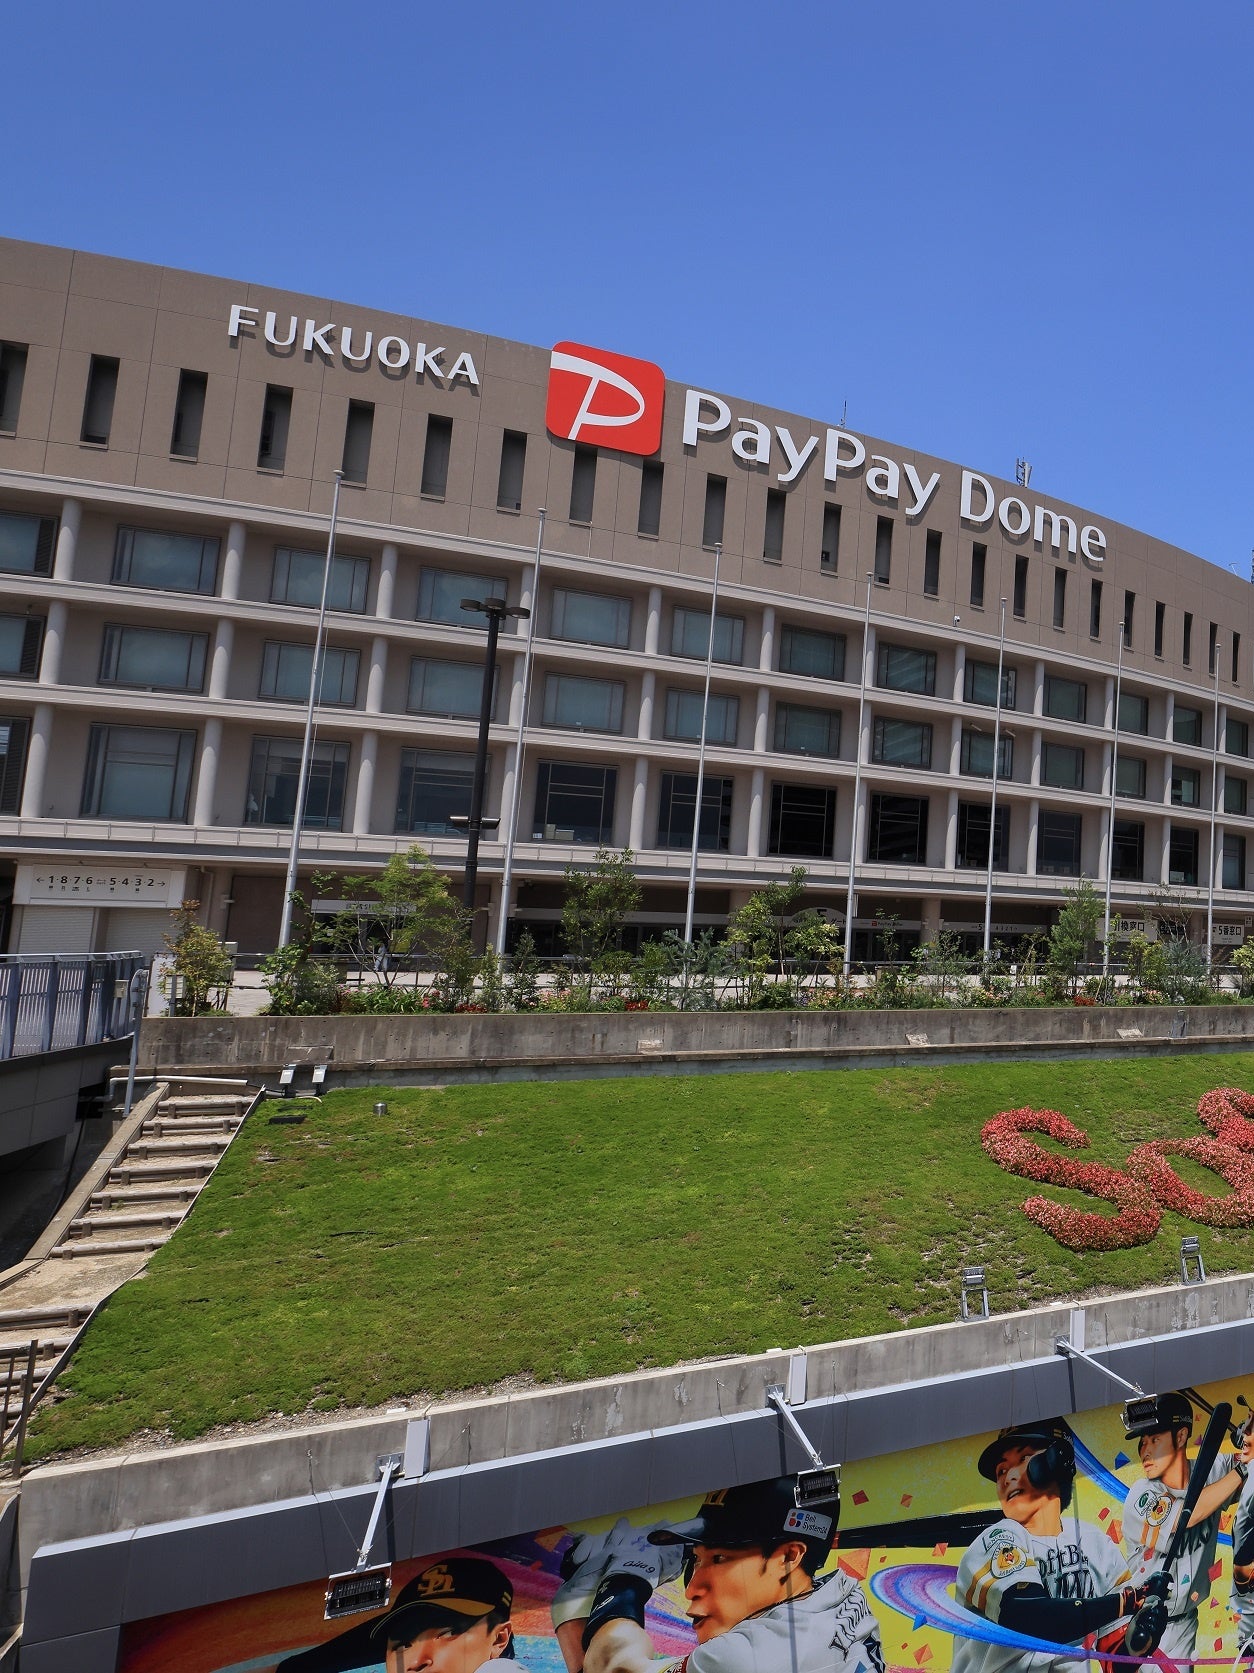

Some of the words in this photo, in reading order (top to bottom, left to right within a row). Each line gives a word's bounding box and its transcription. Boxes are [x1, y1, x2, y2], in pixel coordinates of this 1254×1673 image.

[228, 304, 480, 385] FUKUOKA
[682, 389, 941, 516] PayPay
[959, 470, 1107, 562] Dome
[1218, 925, 1242, 936] 5番窓口
[802, 1521, 828, 1535] System24
